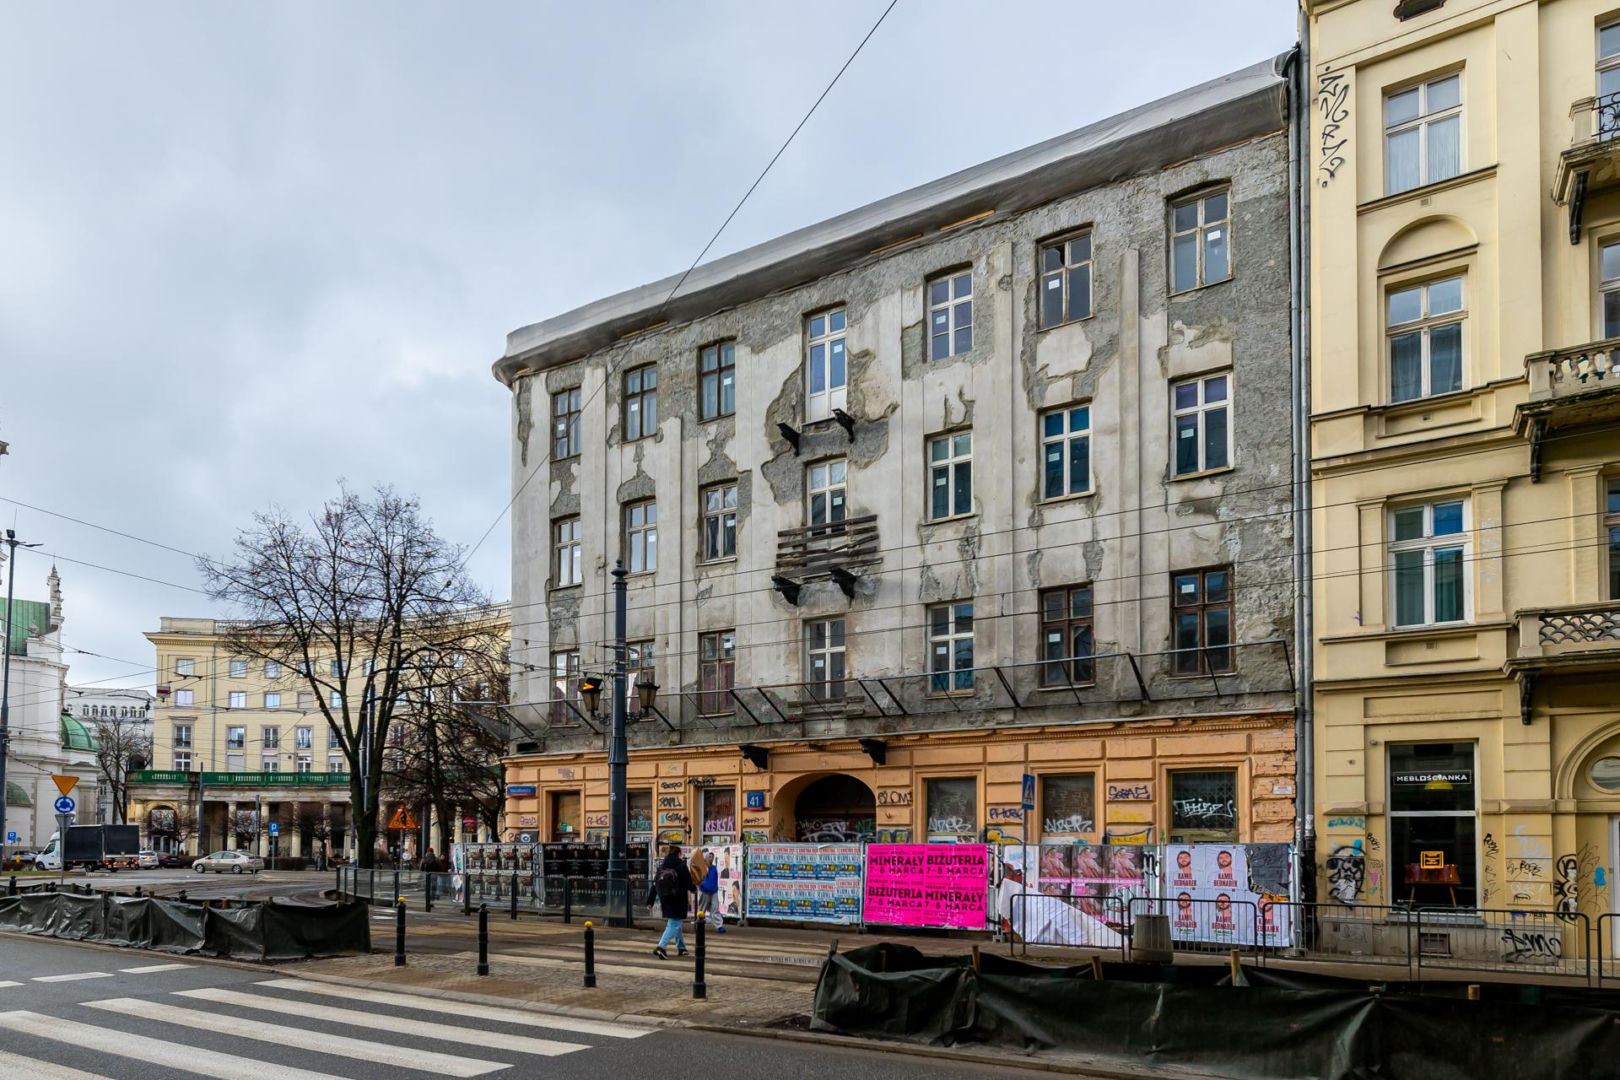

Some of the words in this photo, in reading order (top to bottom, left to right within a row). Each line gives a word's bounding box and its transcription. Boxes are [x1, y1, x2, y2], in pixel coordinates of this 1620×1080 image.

[749, 796, 759, 806] 41
[869, 855, 925, 866] MINERAŁY
[926, 852, 985, 866] BIŻUTERIA
[868, 884, 923, 899] BIŻUTERIA
[925, 890, 984, 902] MINERAŁY
[887, 899, 923, 908] MARCA
[945, 903, 984, 911] MARCA
